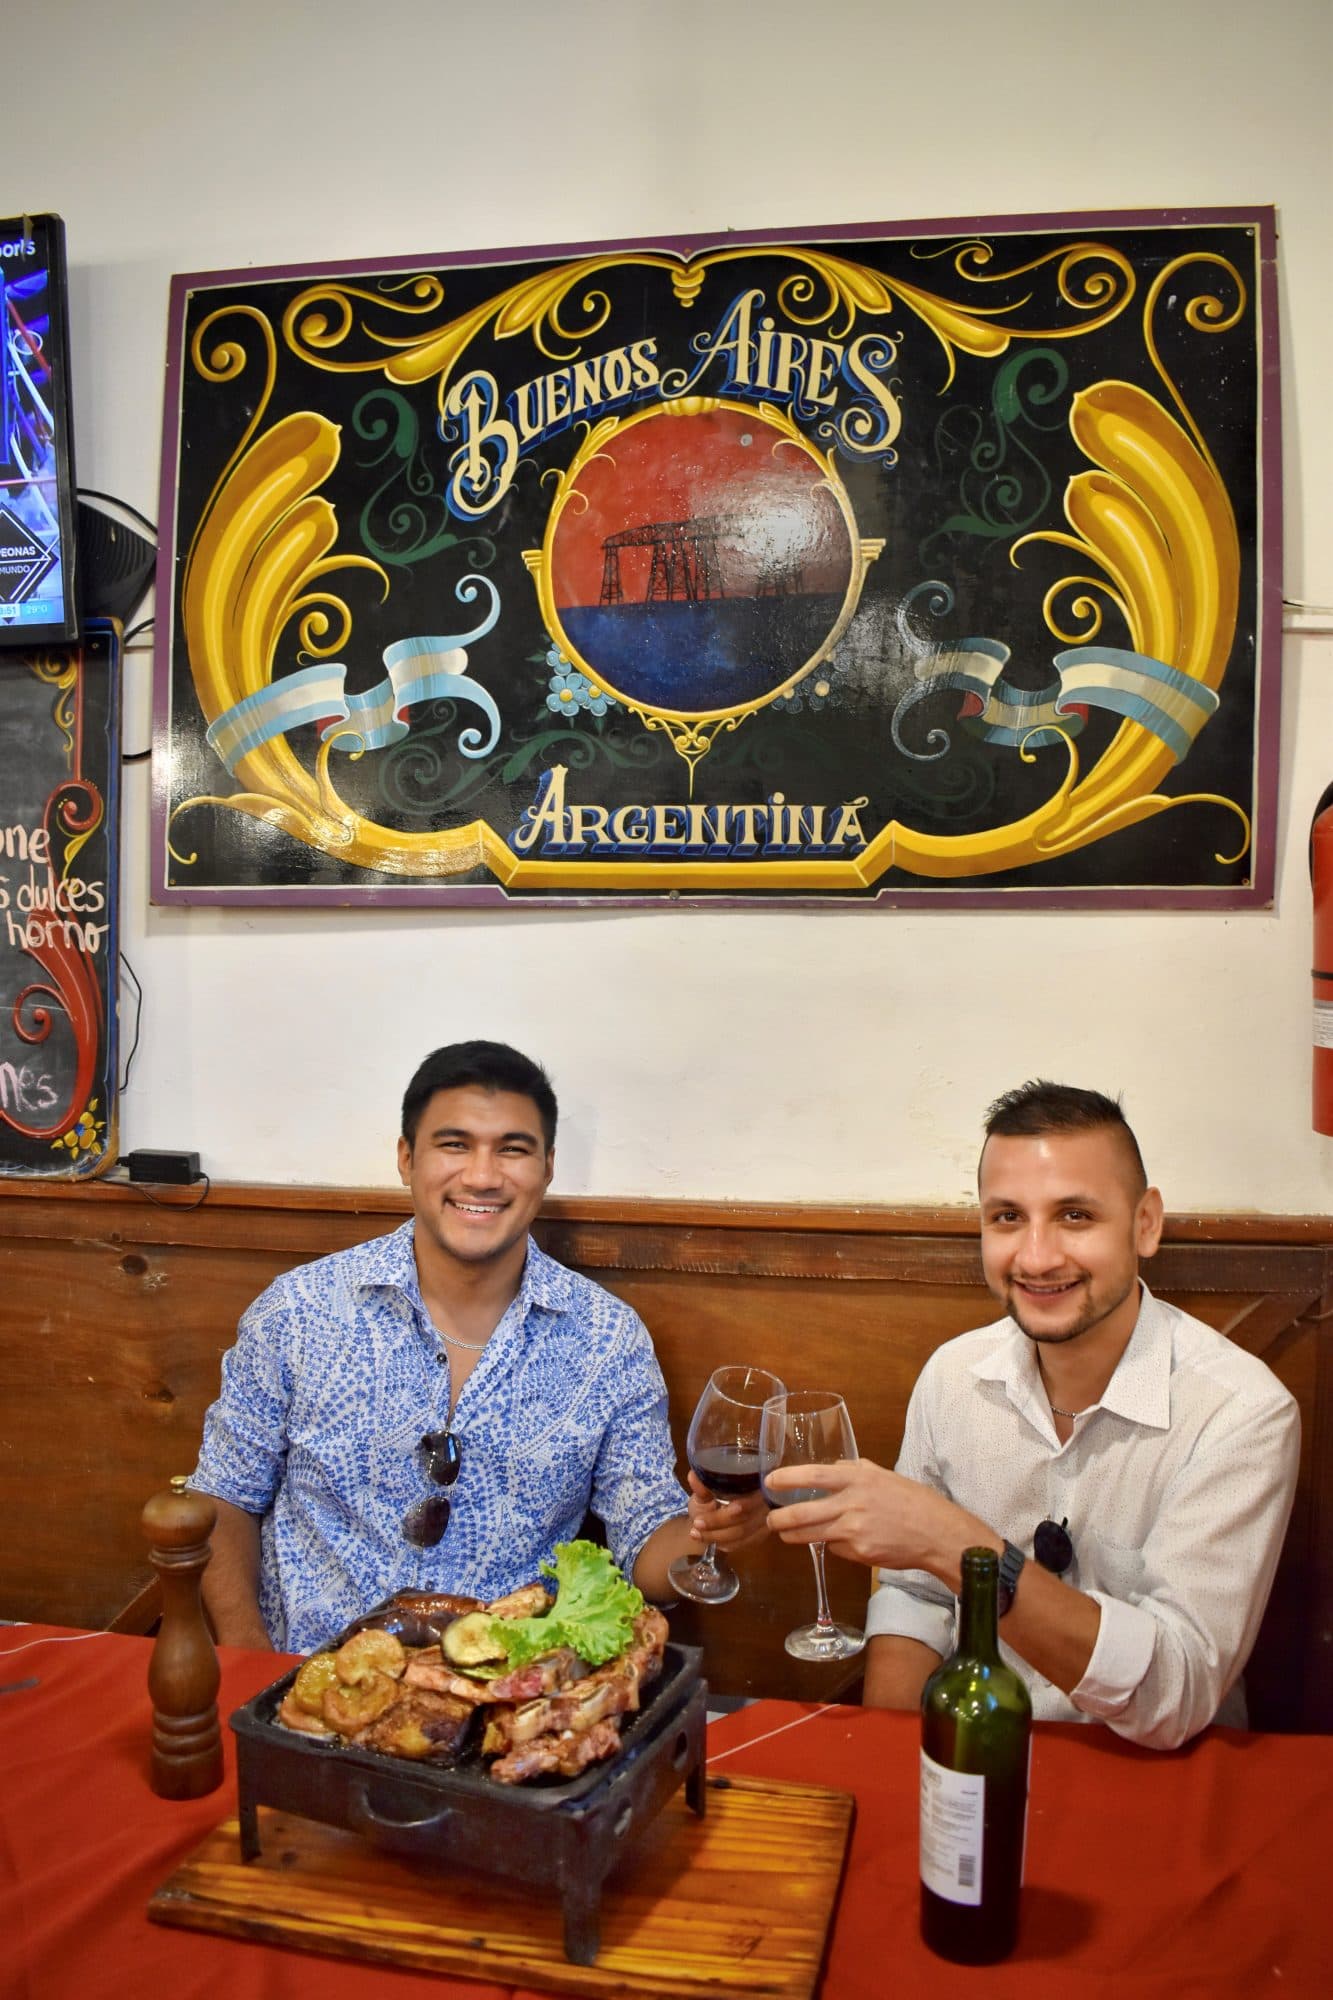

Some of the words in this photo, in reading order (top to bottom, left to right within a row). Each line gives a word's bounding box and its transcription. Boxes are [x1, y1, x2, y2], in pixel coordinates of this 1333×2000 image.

[440, 337, 661, 518] BUENOS
[658, 288, 905, 468] AIRES
[17, 864, 104, 912] dulces
[7, 910, 110, 953] horno
